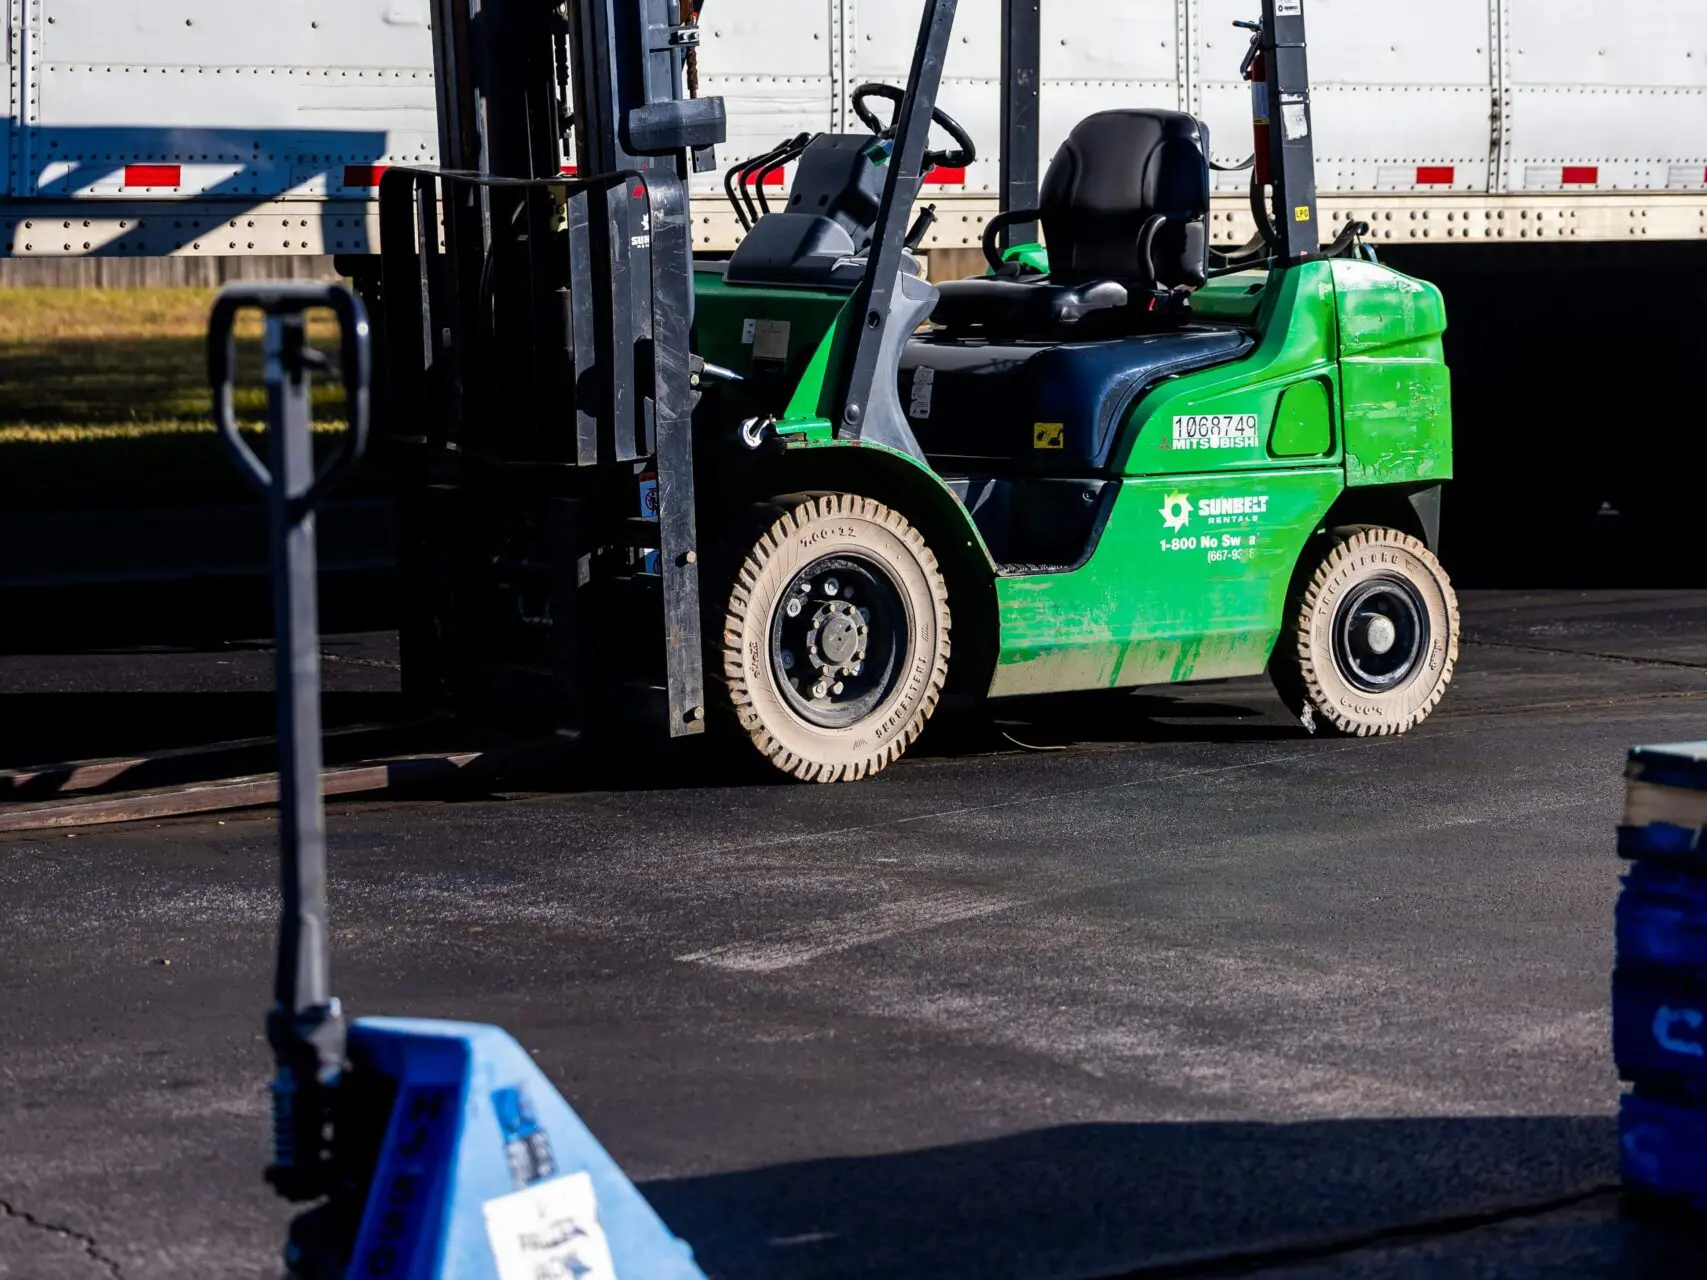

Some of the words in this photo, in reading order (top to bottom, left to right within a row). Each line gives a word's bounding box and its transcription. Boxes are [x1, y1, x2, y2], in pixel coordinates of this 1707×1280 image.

[1175, 415, 1257, 438] 1068749
[1198, 495, 1269, 516] SUNBELT
[1160, 536, 1197, 552] 1-800
[1200, 535, 1218, 549] No
